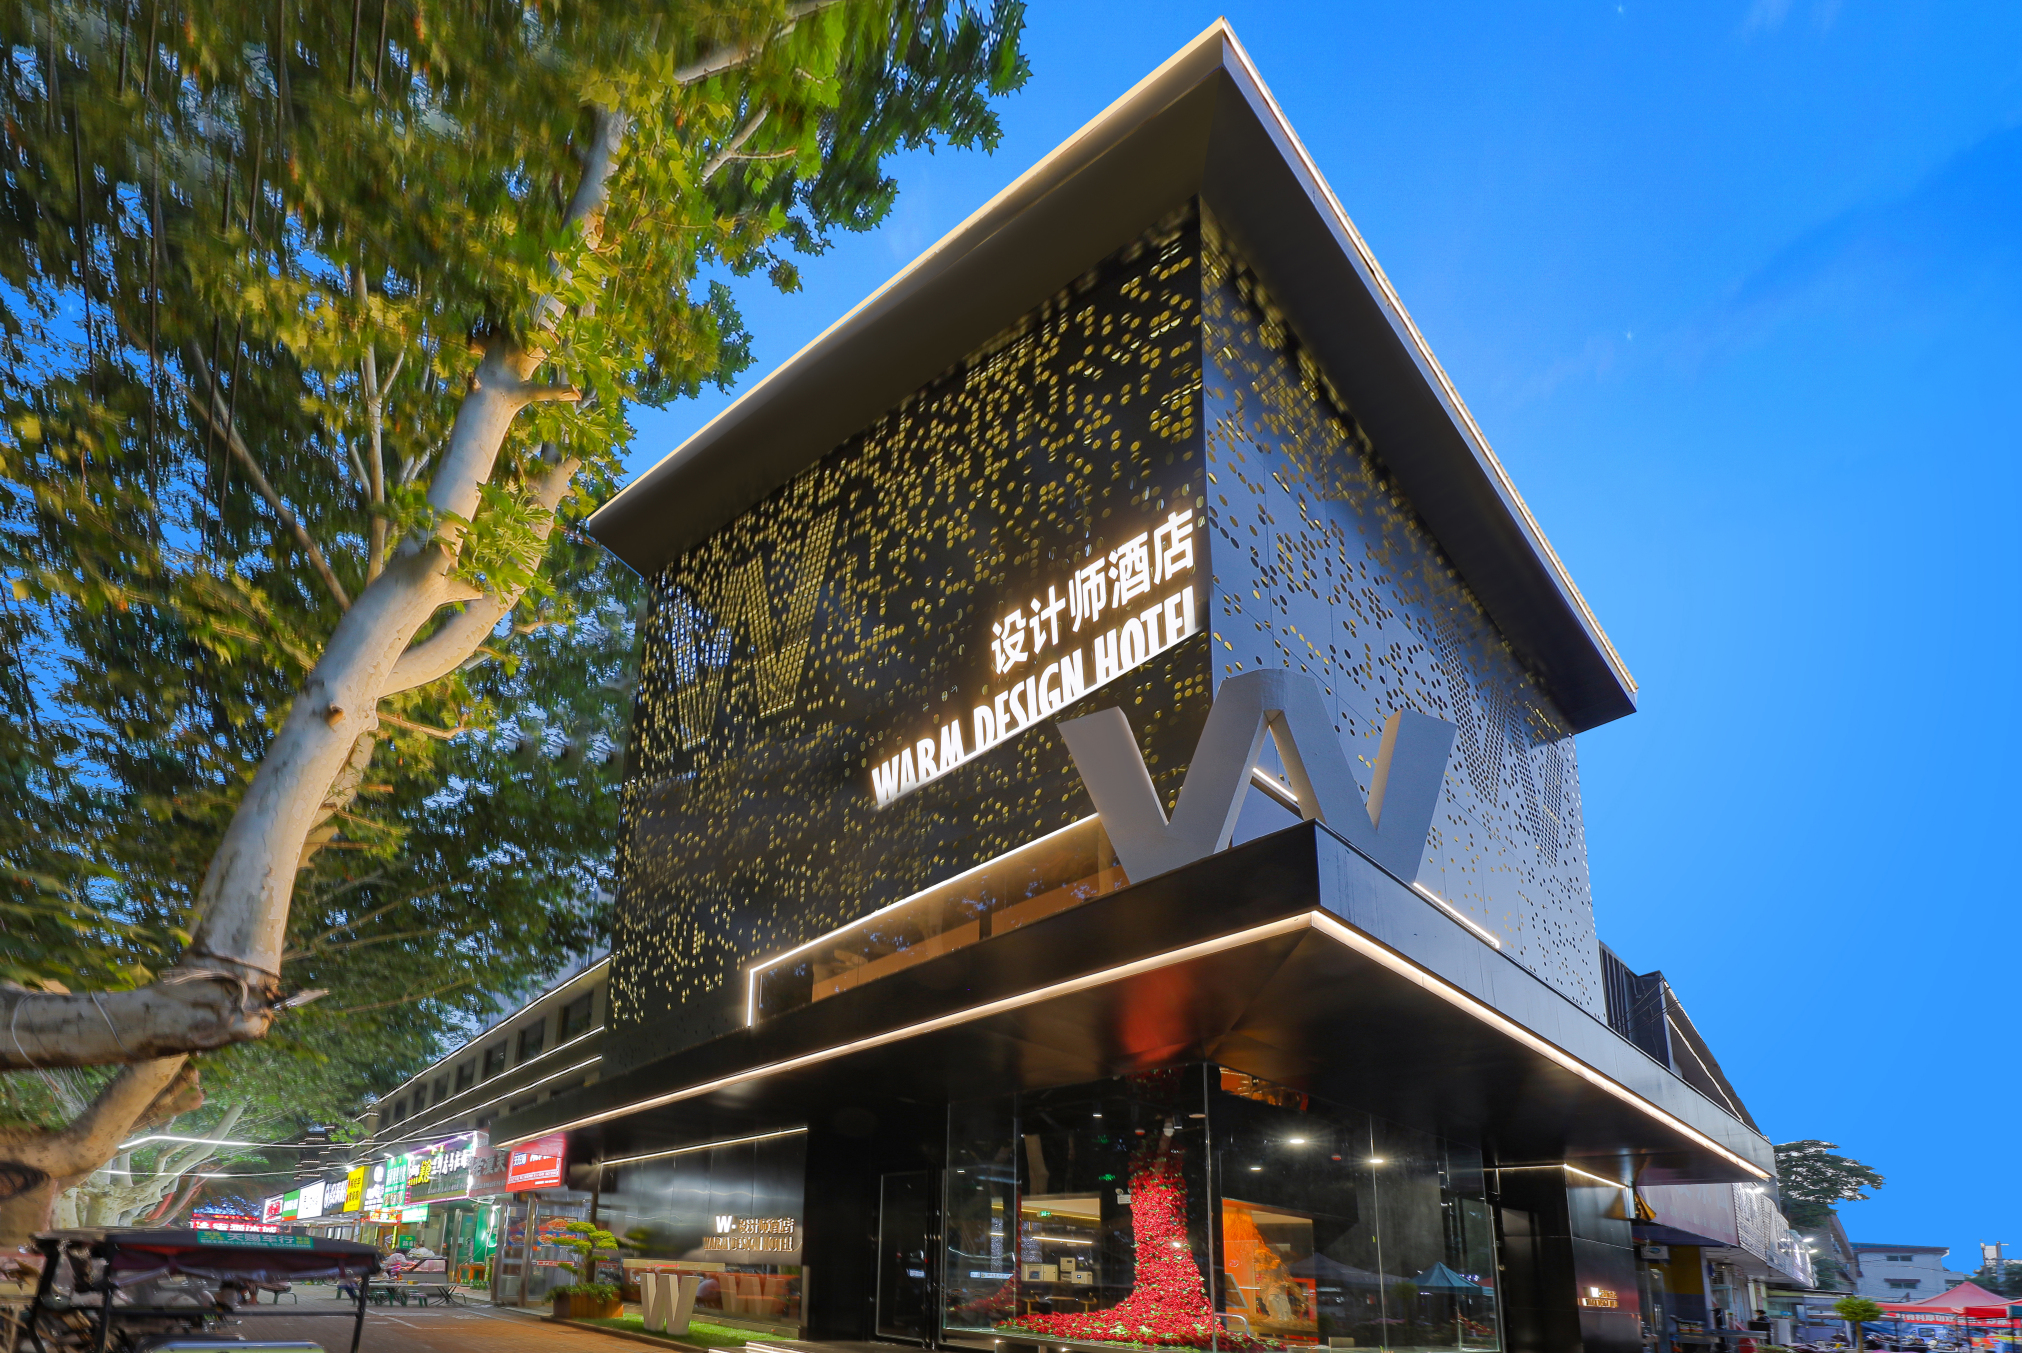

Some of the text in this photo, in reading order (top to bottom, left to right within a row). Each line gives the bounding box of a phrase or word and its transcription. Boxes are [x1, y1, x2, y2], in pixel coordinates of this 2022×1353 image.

[991, 508, 1195, 675] 设计师酒店
[871, 586, 1197, 808] WARM DESIGN HOTEL
[1056, 669, 1457, 884] W
[227, 1232, 295, 1244] 天赐车行
[640, 1272, 700, 1335] W
